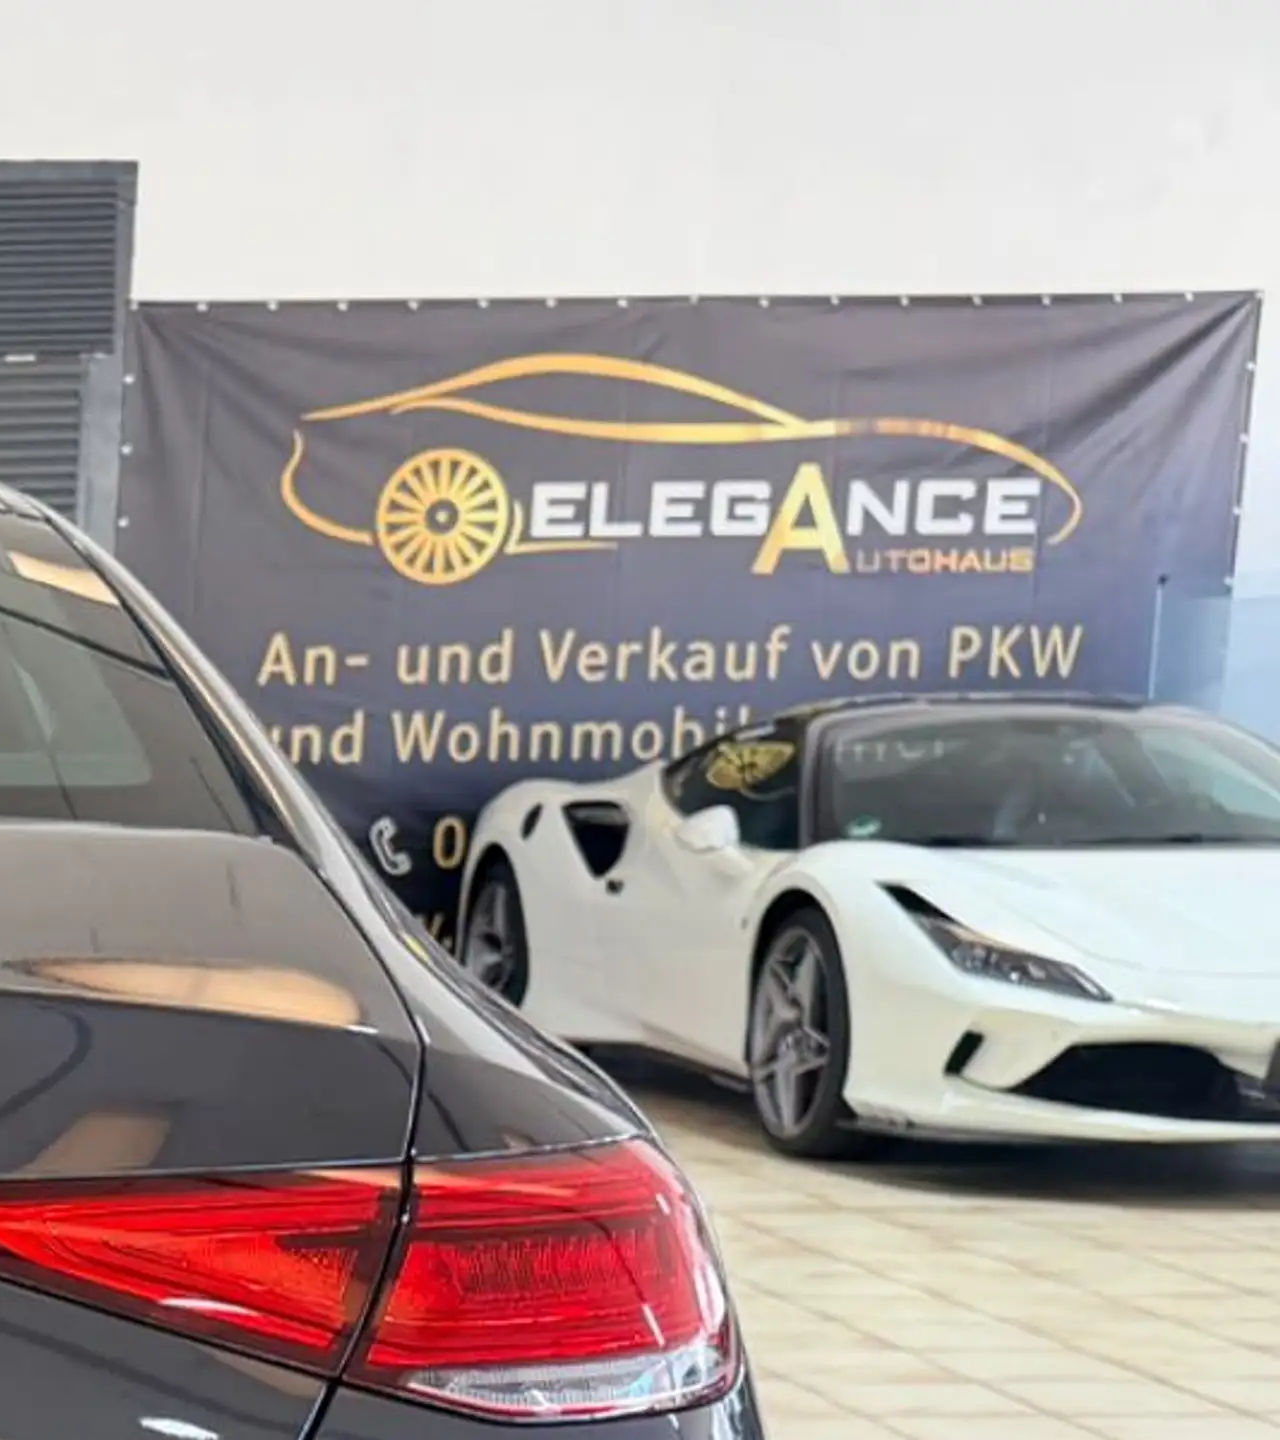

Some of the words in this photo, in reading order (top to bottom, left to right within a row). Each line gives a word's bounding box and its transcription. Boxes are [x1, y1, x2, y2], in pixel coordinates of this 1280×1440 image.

[529, 461, 1042, 575] ELEGANCE
[256, 631, 370, 687] An-
[395, 627, 516, 685] und
[538, 624, 792, 684] Verkauf
[810, 636, 922, 682] von
[948, 624, 1085, 682] PKW
